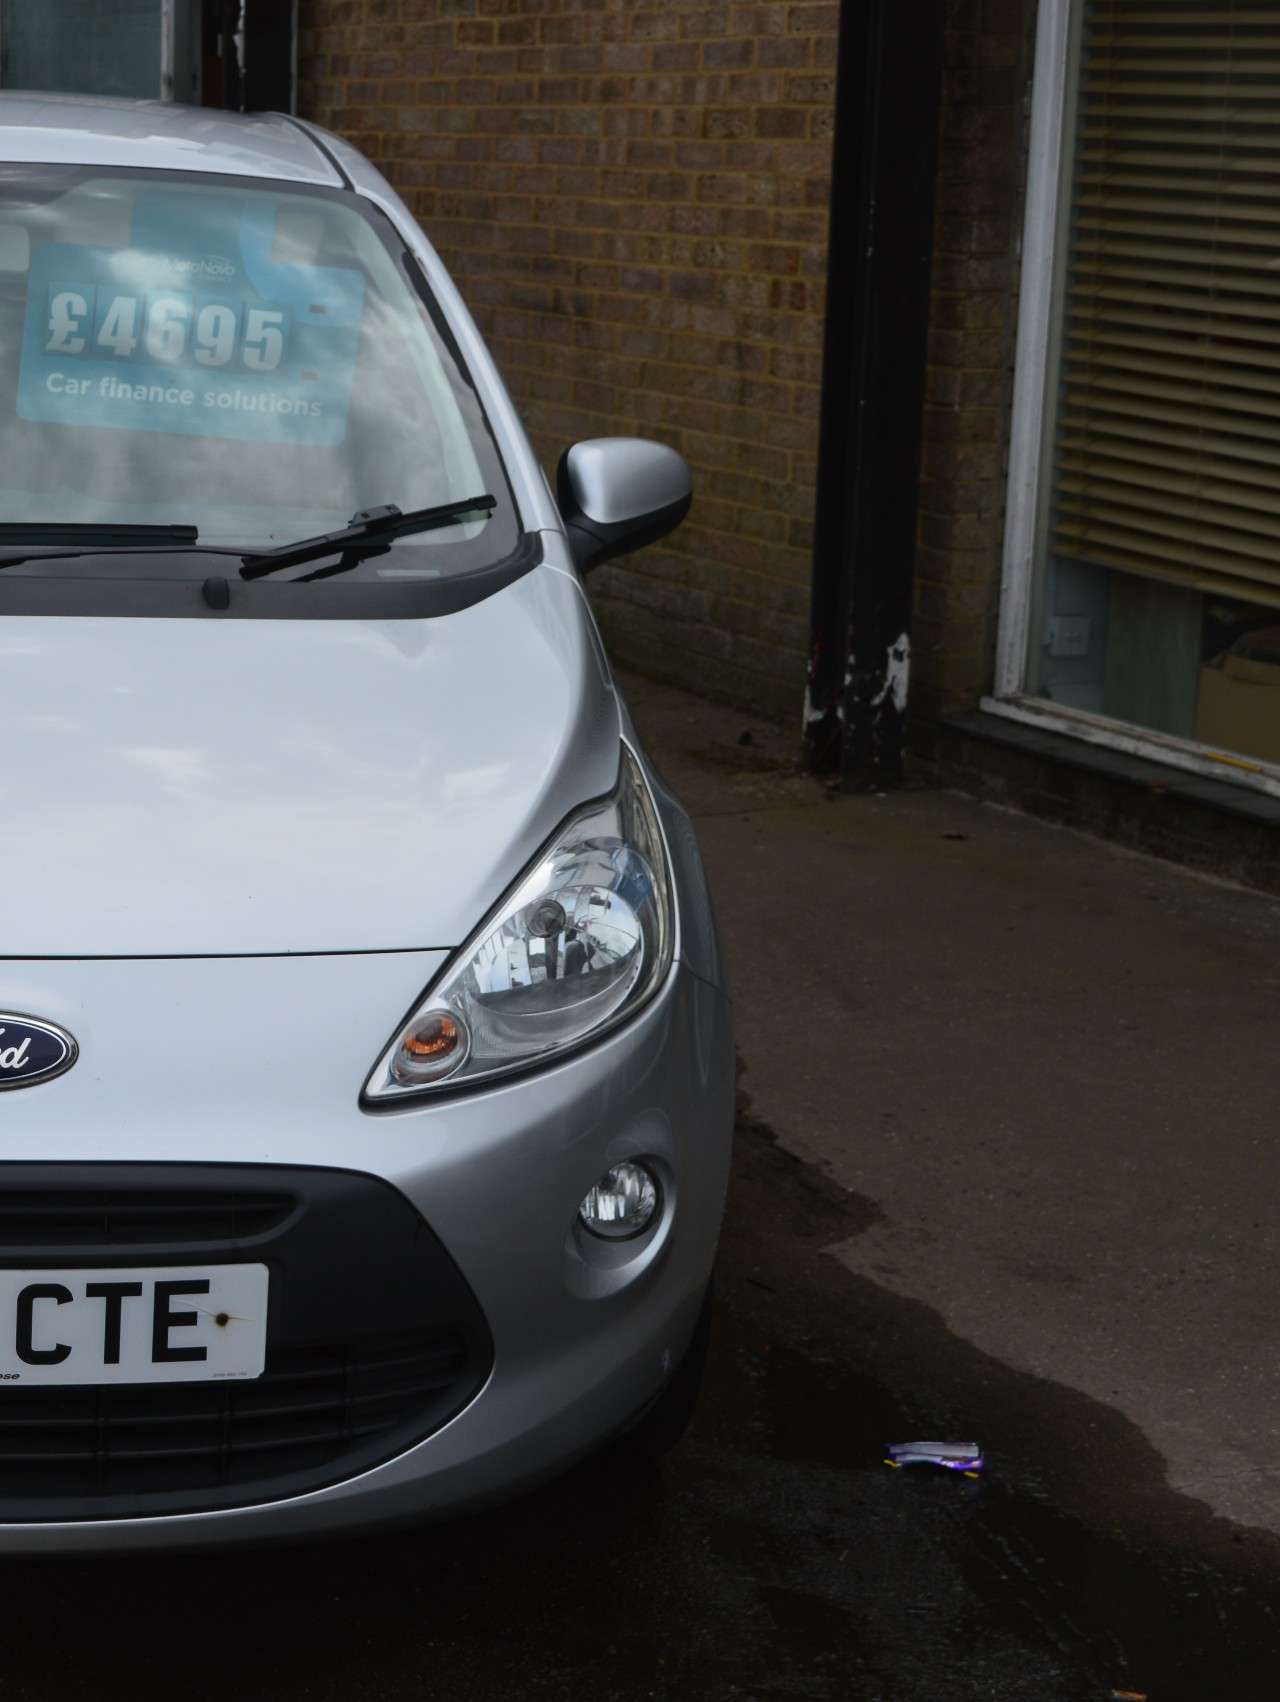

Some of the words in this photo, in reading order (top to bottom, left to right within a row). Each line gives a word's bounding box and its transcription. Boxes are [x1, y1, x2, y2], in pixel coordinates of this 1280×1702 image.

[46, 292, 284, 371] £4695
[46, 373, 90, 396] Car
[99, 376, 195, 406] finance
[203, 390, 322, 417] solutions
[15, 1279, 210, 1365] CTE
